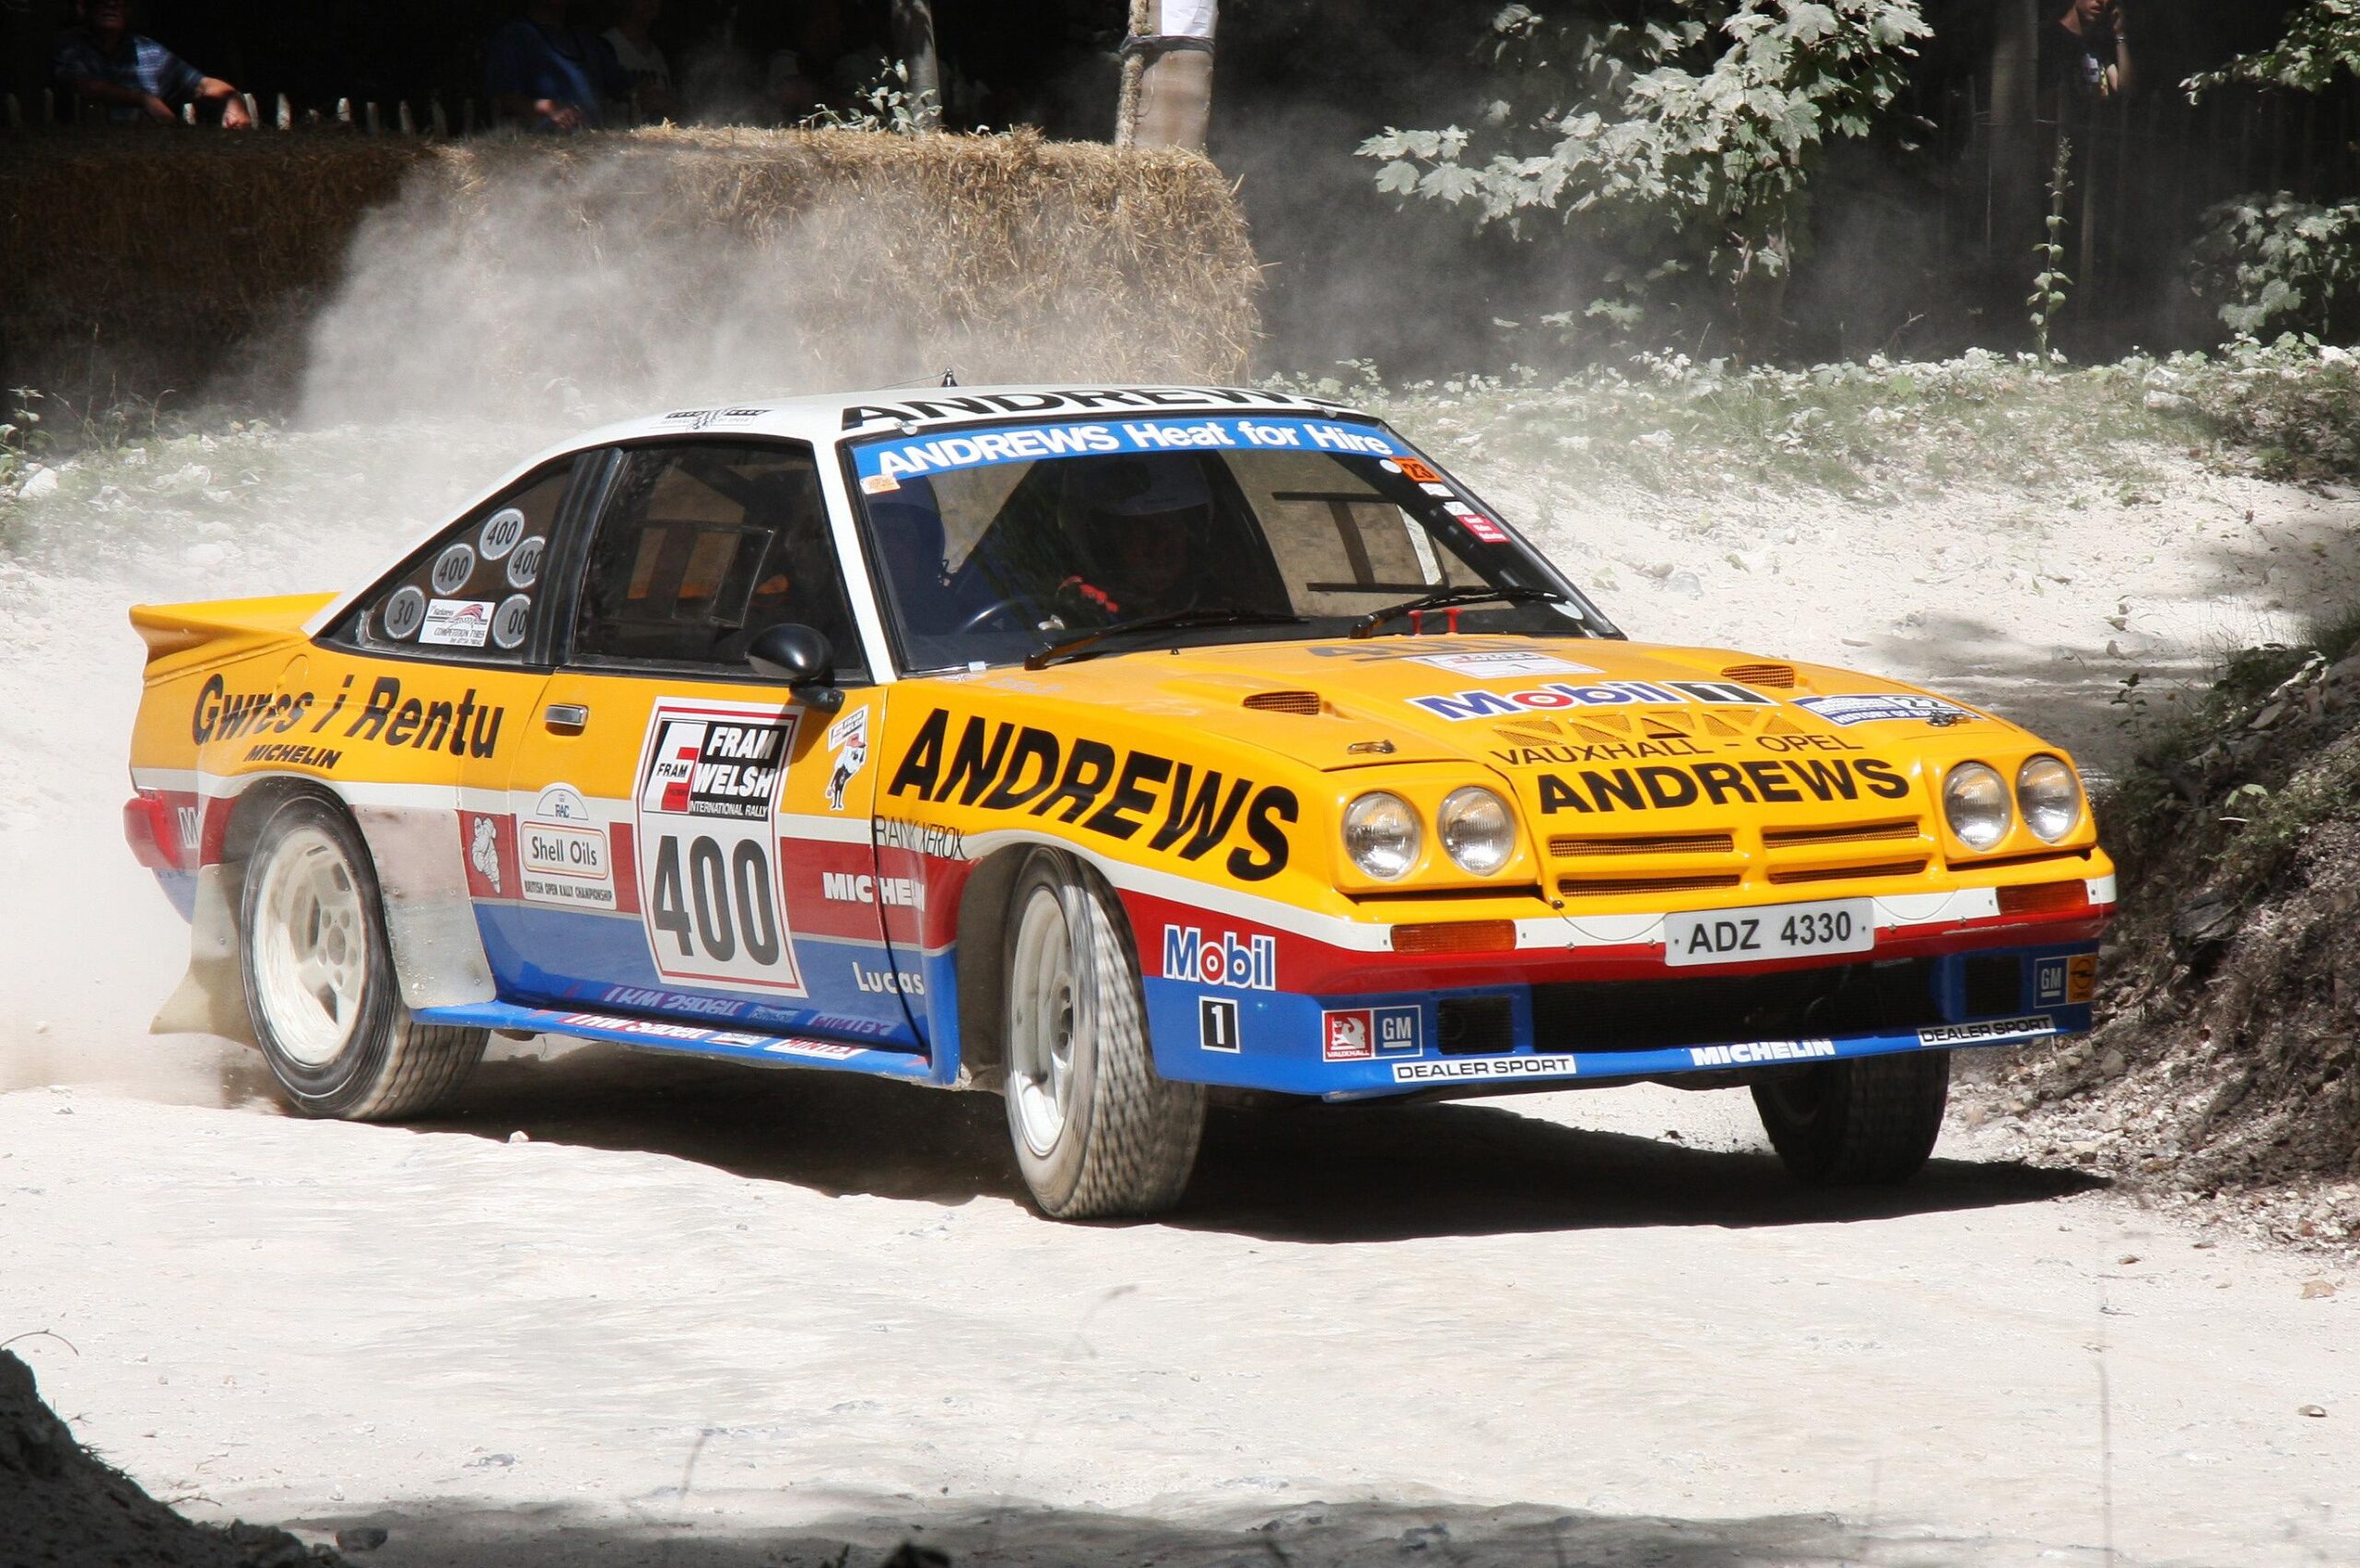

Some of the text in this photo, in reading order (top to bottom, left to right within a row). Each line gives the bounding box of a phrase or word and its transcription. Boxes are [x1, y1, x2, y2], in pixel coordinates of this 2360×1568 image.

[841, 387, 1350, 430] ANDREW
[878, 420, 1393, 477] ANDREWS Heat for Hire
[1401, 462, 1435, 479] 23
[486, 520, 519, 547] 400
[437, 555, 469, 583] 400
[1410, 680, 1689, 719] Mobil
[191, 672, 506, 760] Gwres i Rentu
[242, 743, 344, 770] MICHELIN
[705, 725, 779, 760] FRAM
[1490, 736, 1713, 765] VAUXHALL
[1755, 733, 1864, 754] OPEL
[656, 762, 689, 778] FRAM
[691, 762, 777, 798] WELSH
[887, 707, 1300, 881] ANDREWS
[1535, 757, 1912, 816] ANDREWS
[555, 804, 570, 819] RAC
[690, 800, 769, 818] INTERNATIONAL RALLY
[531, 835, 597, 867] Shell Oils
[918, 821, 968, 860] XEROX
[652, 834, 780, 966] 400
[1688, 911, 1852, 955] ADZ 4330
[1162, 924, 1277, 991] Mobil
[852, 961, 926, 996] Lucas
[2040, 966, 2062, 990] GM
[1382, 1016, 1412, 1041] GM
[1920, 1015, 2053, 1043] DEALER SPORT
[1398, 1057, 1571, 1079] DEALER SPORT
[1690, 1038, 1837, 1067] MICHELIN
